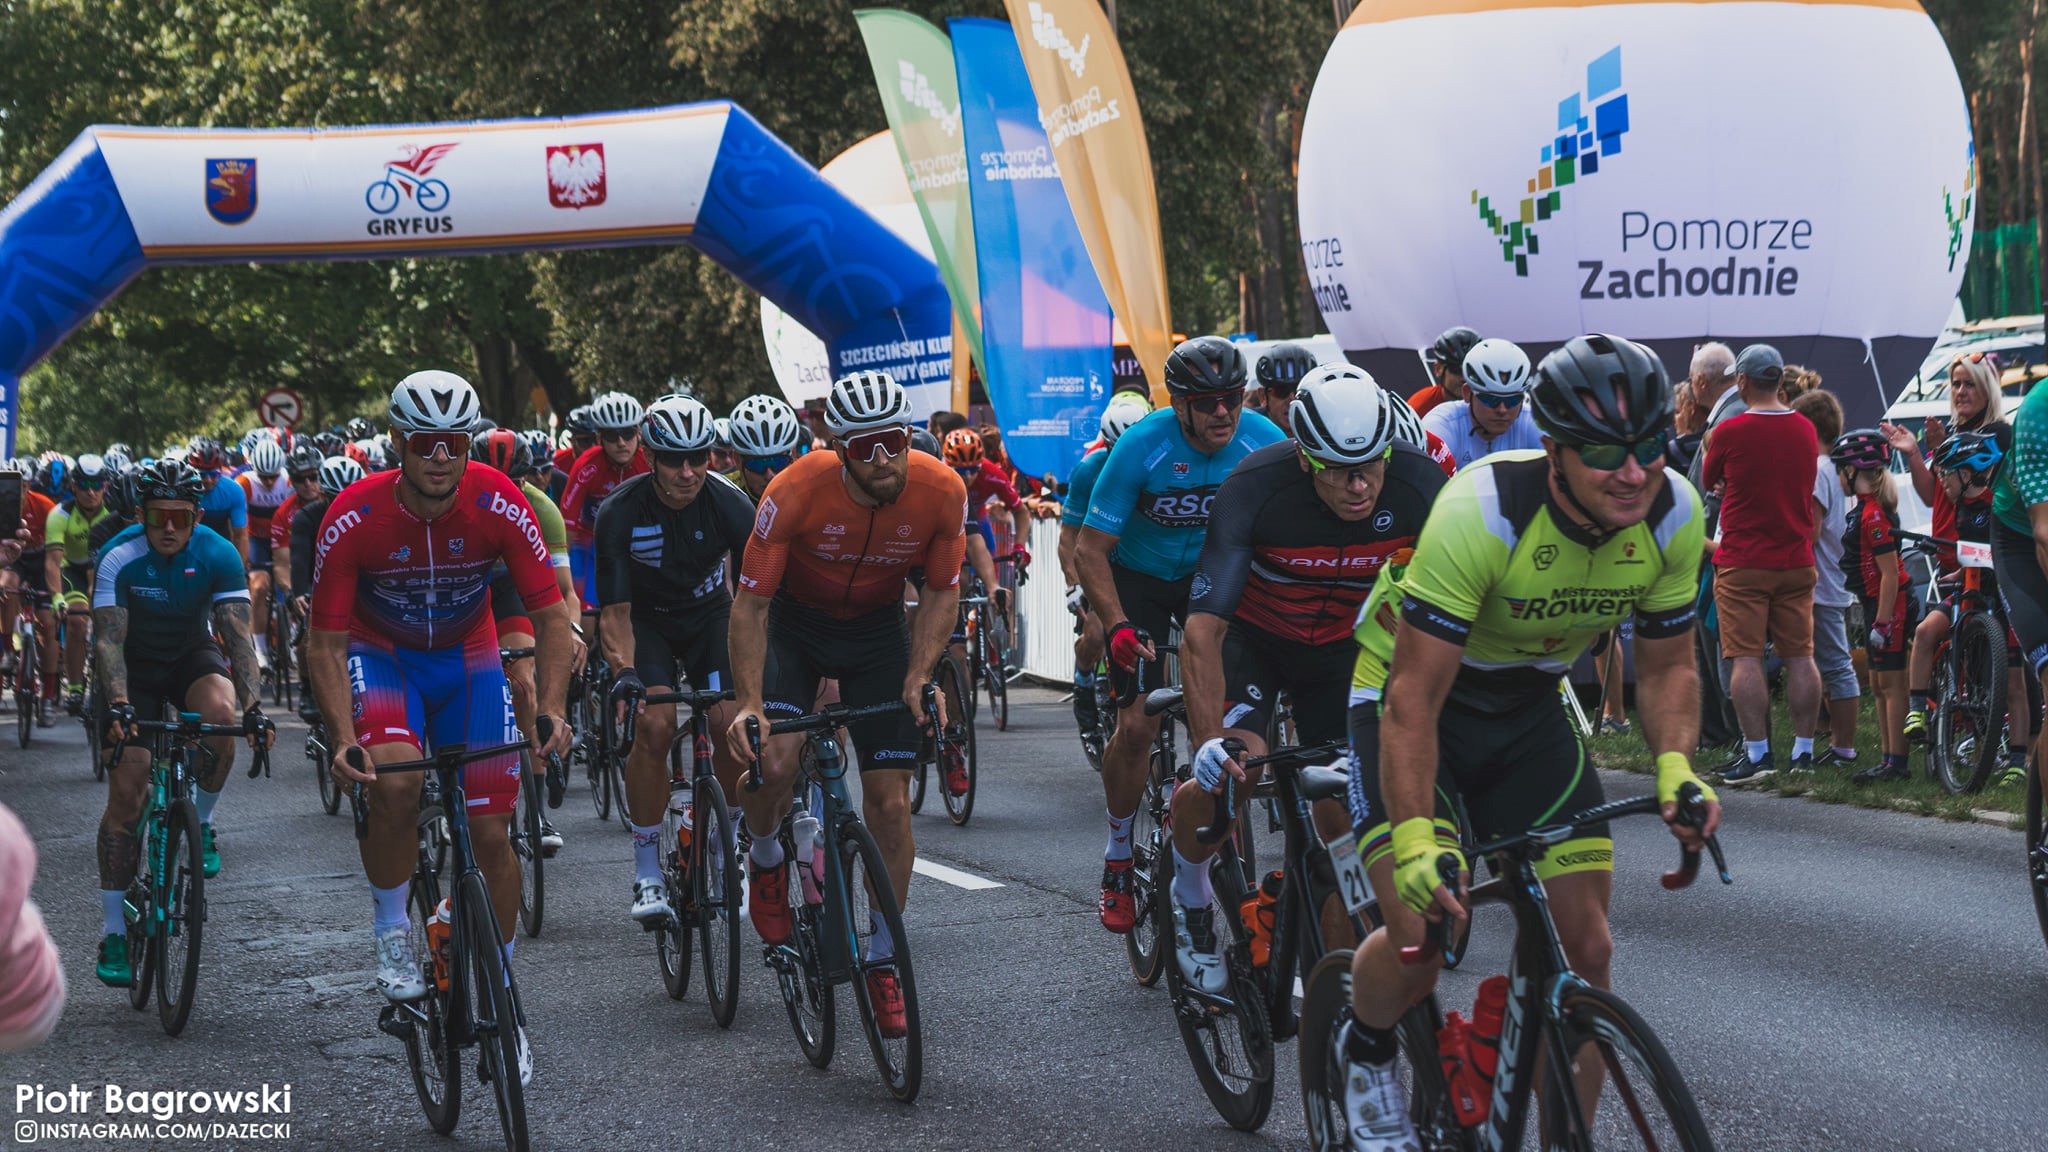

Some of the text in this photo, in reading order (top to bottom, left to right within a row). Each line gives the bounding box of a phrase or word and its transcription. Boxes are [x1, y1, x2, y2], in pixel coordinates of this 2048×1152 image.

[366, 216, 453, 236] GRYFUS
[1622, 211, 1813, 253] Pomorze
[1578, 256, 1799, 300] Zachodnie
[839, 339, 926, 367] SZCZECIŃSKI
[312, 510, 362, 584] bekom
[476, 492, 547, 562] abekom
[825, 524, 845, 532] 2x3
[1344, 864, 1369, 905] 21
